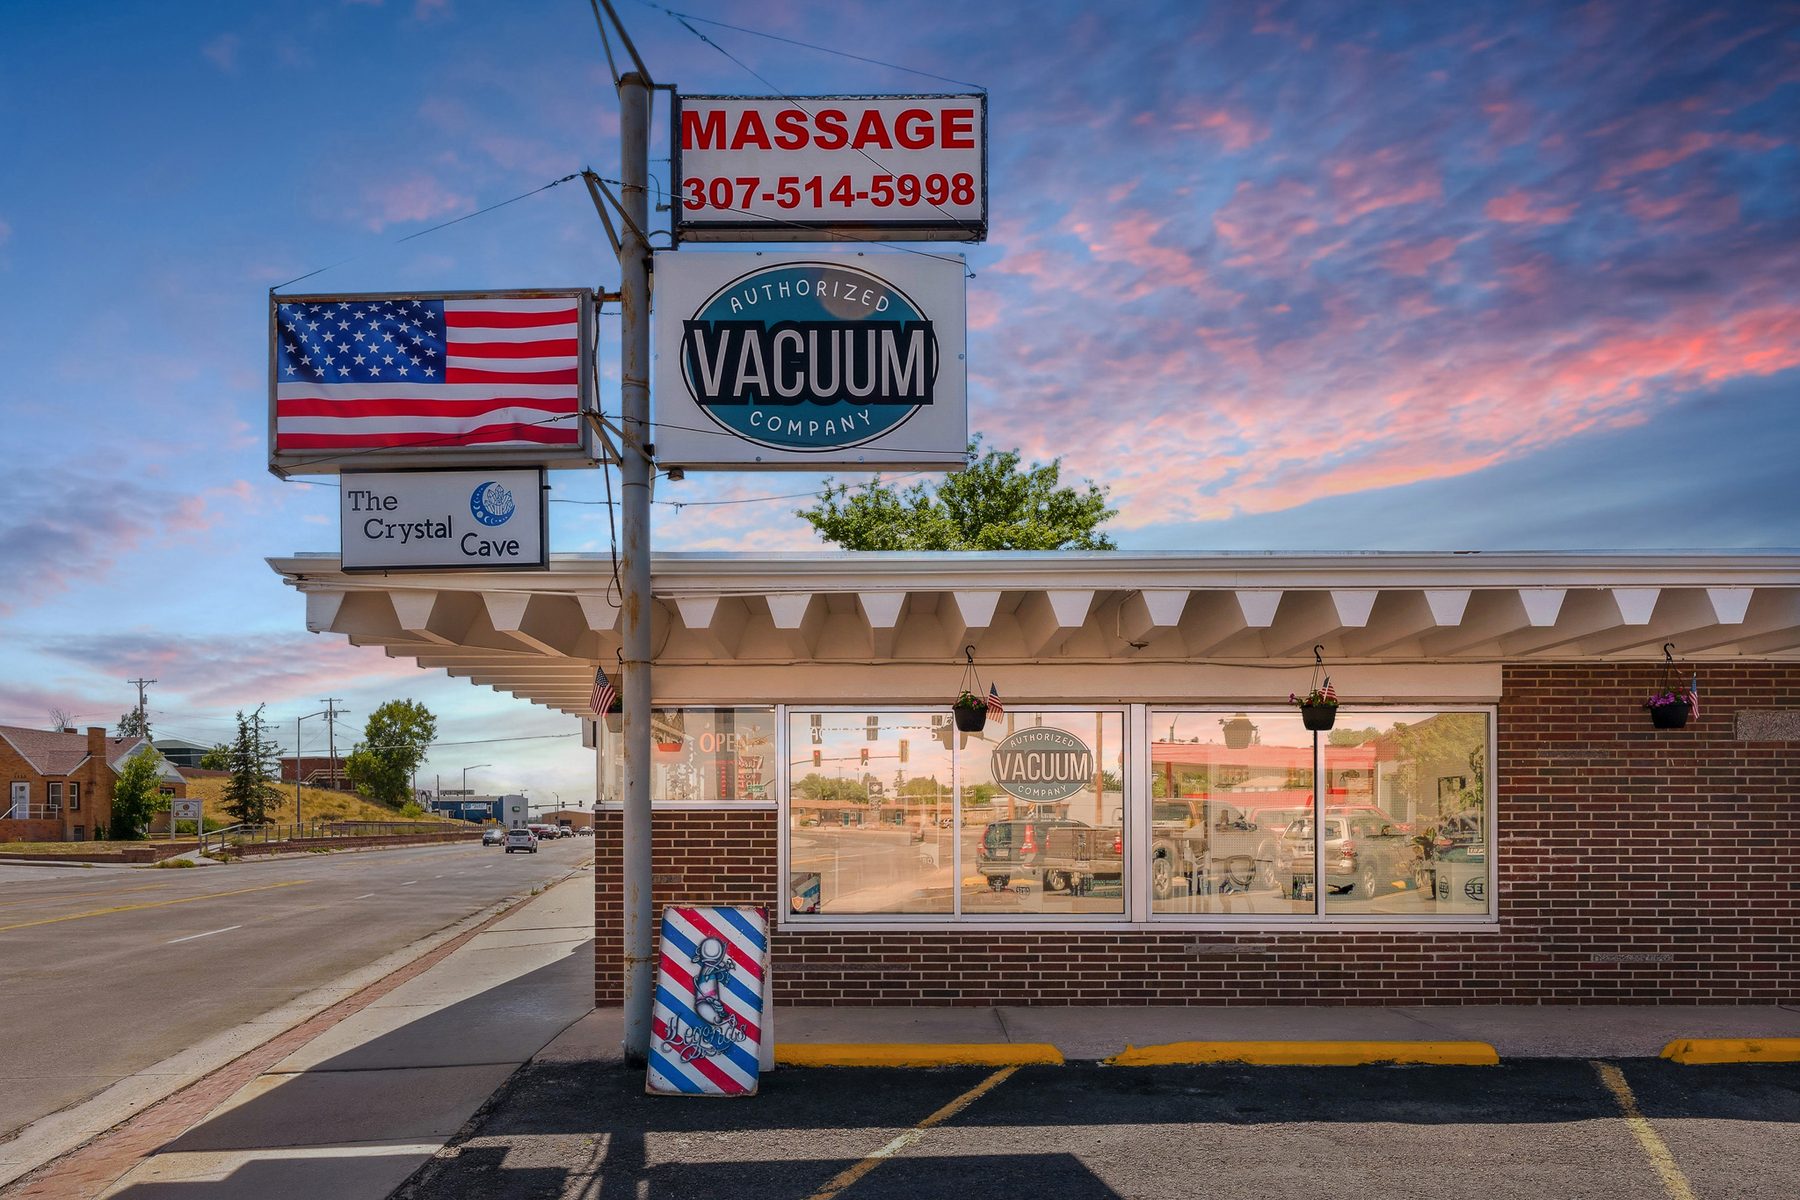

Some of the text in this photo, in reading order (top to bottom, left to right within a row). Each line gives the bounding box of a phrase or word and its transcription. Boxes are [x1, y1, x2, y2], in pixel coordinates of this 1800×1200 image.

[682, 109, 975, 150] MASSAGE
[682, 173, 975, 210] 307-514-5998
[731, 279, 889, 314] AUTHORIZED
[694, 329, 925, 398] VACUUM
[750, 410, 871, 437] COMPANY
[348, 490, 399, 512] The
[364, 515, 453, 544] Crystal
[460, 533, 520, 557] Cave
[1010, 733, 1075, 748] AUTHORIZED
[996, 752, 1088, 781] VACUUM
[1017, 785, 1067, 797] COMPANY
[661, 1013, 747, 1063] Legends
